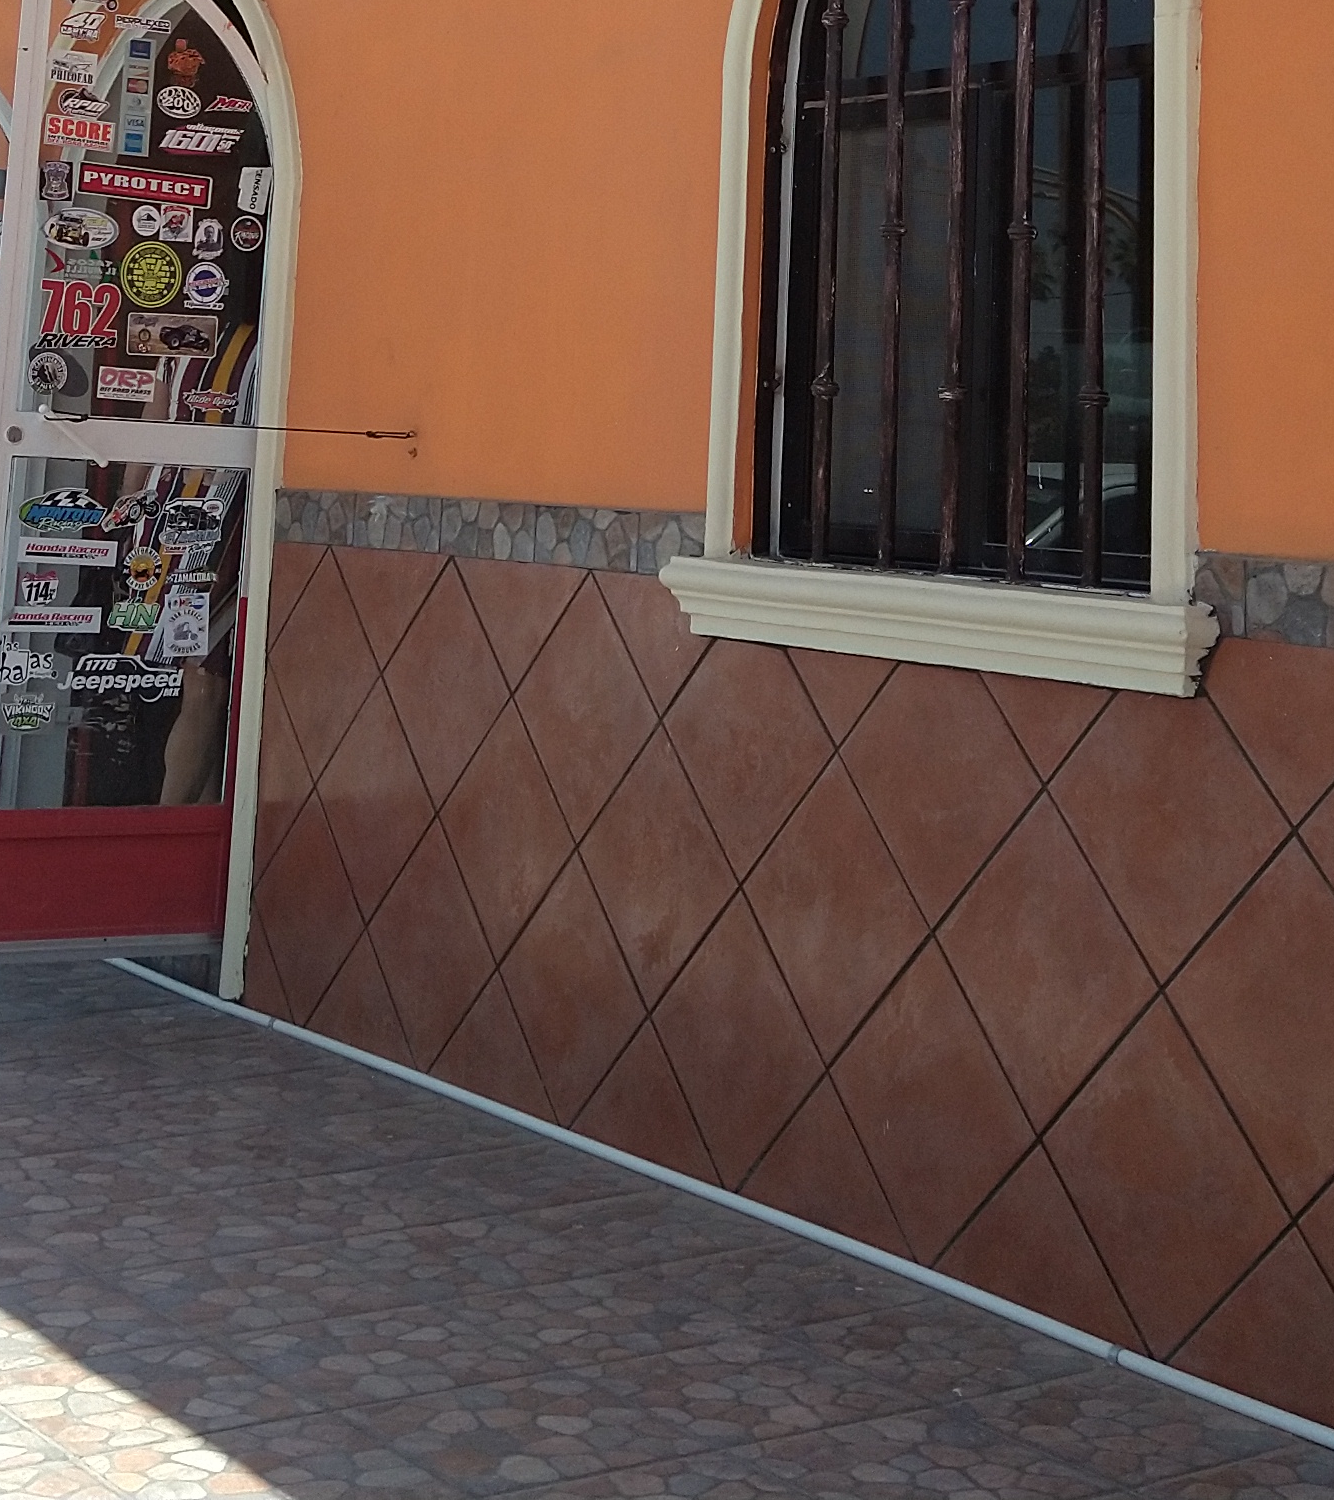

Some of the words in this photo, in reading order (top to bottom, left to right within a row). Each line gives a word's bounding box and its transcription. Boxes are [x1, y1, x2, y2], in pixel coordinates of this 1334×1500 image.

[50, 68, 94, 85] PHILOFAB
[48, 117, 112, 142] SCORE
[127, 119, 145, 127] VISA
[83, 170, 205, 197] PYROTECT
[40, 279, 121, 338] 762
[35, 333, 116, 348] RIVERA
[100, 368, 154, 389] ORP
[27, 505, 102, 523] MONTOYA
[26, 542, 67, 552] Honda
[68, 546, 109, 557] Racing
[51, 613, 93, 623] Racing
[109, 603, 160, 627] HN
[85, 660, 118, 671] 1776
[57, 669, 184, 693] Jeepspeed
[3, 704, 54, 719] VIKINGOS
